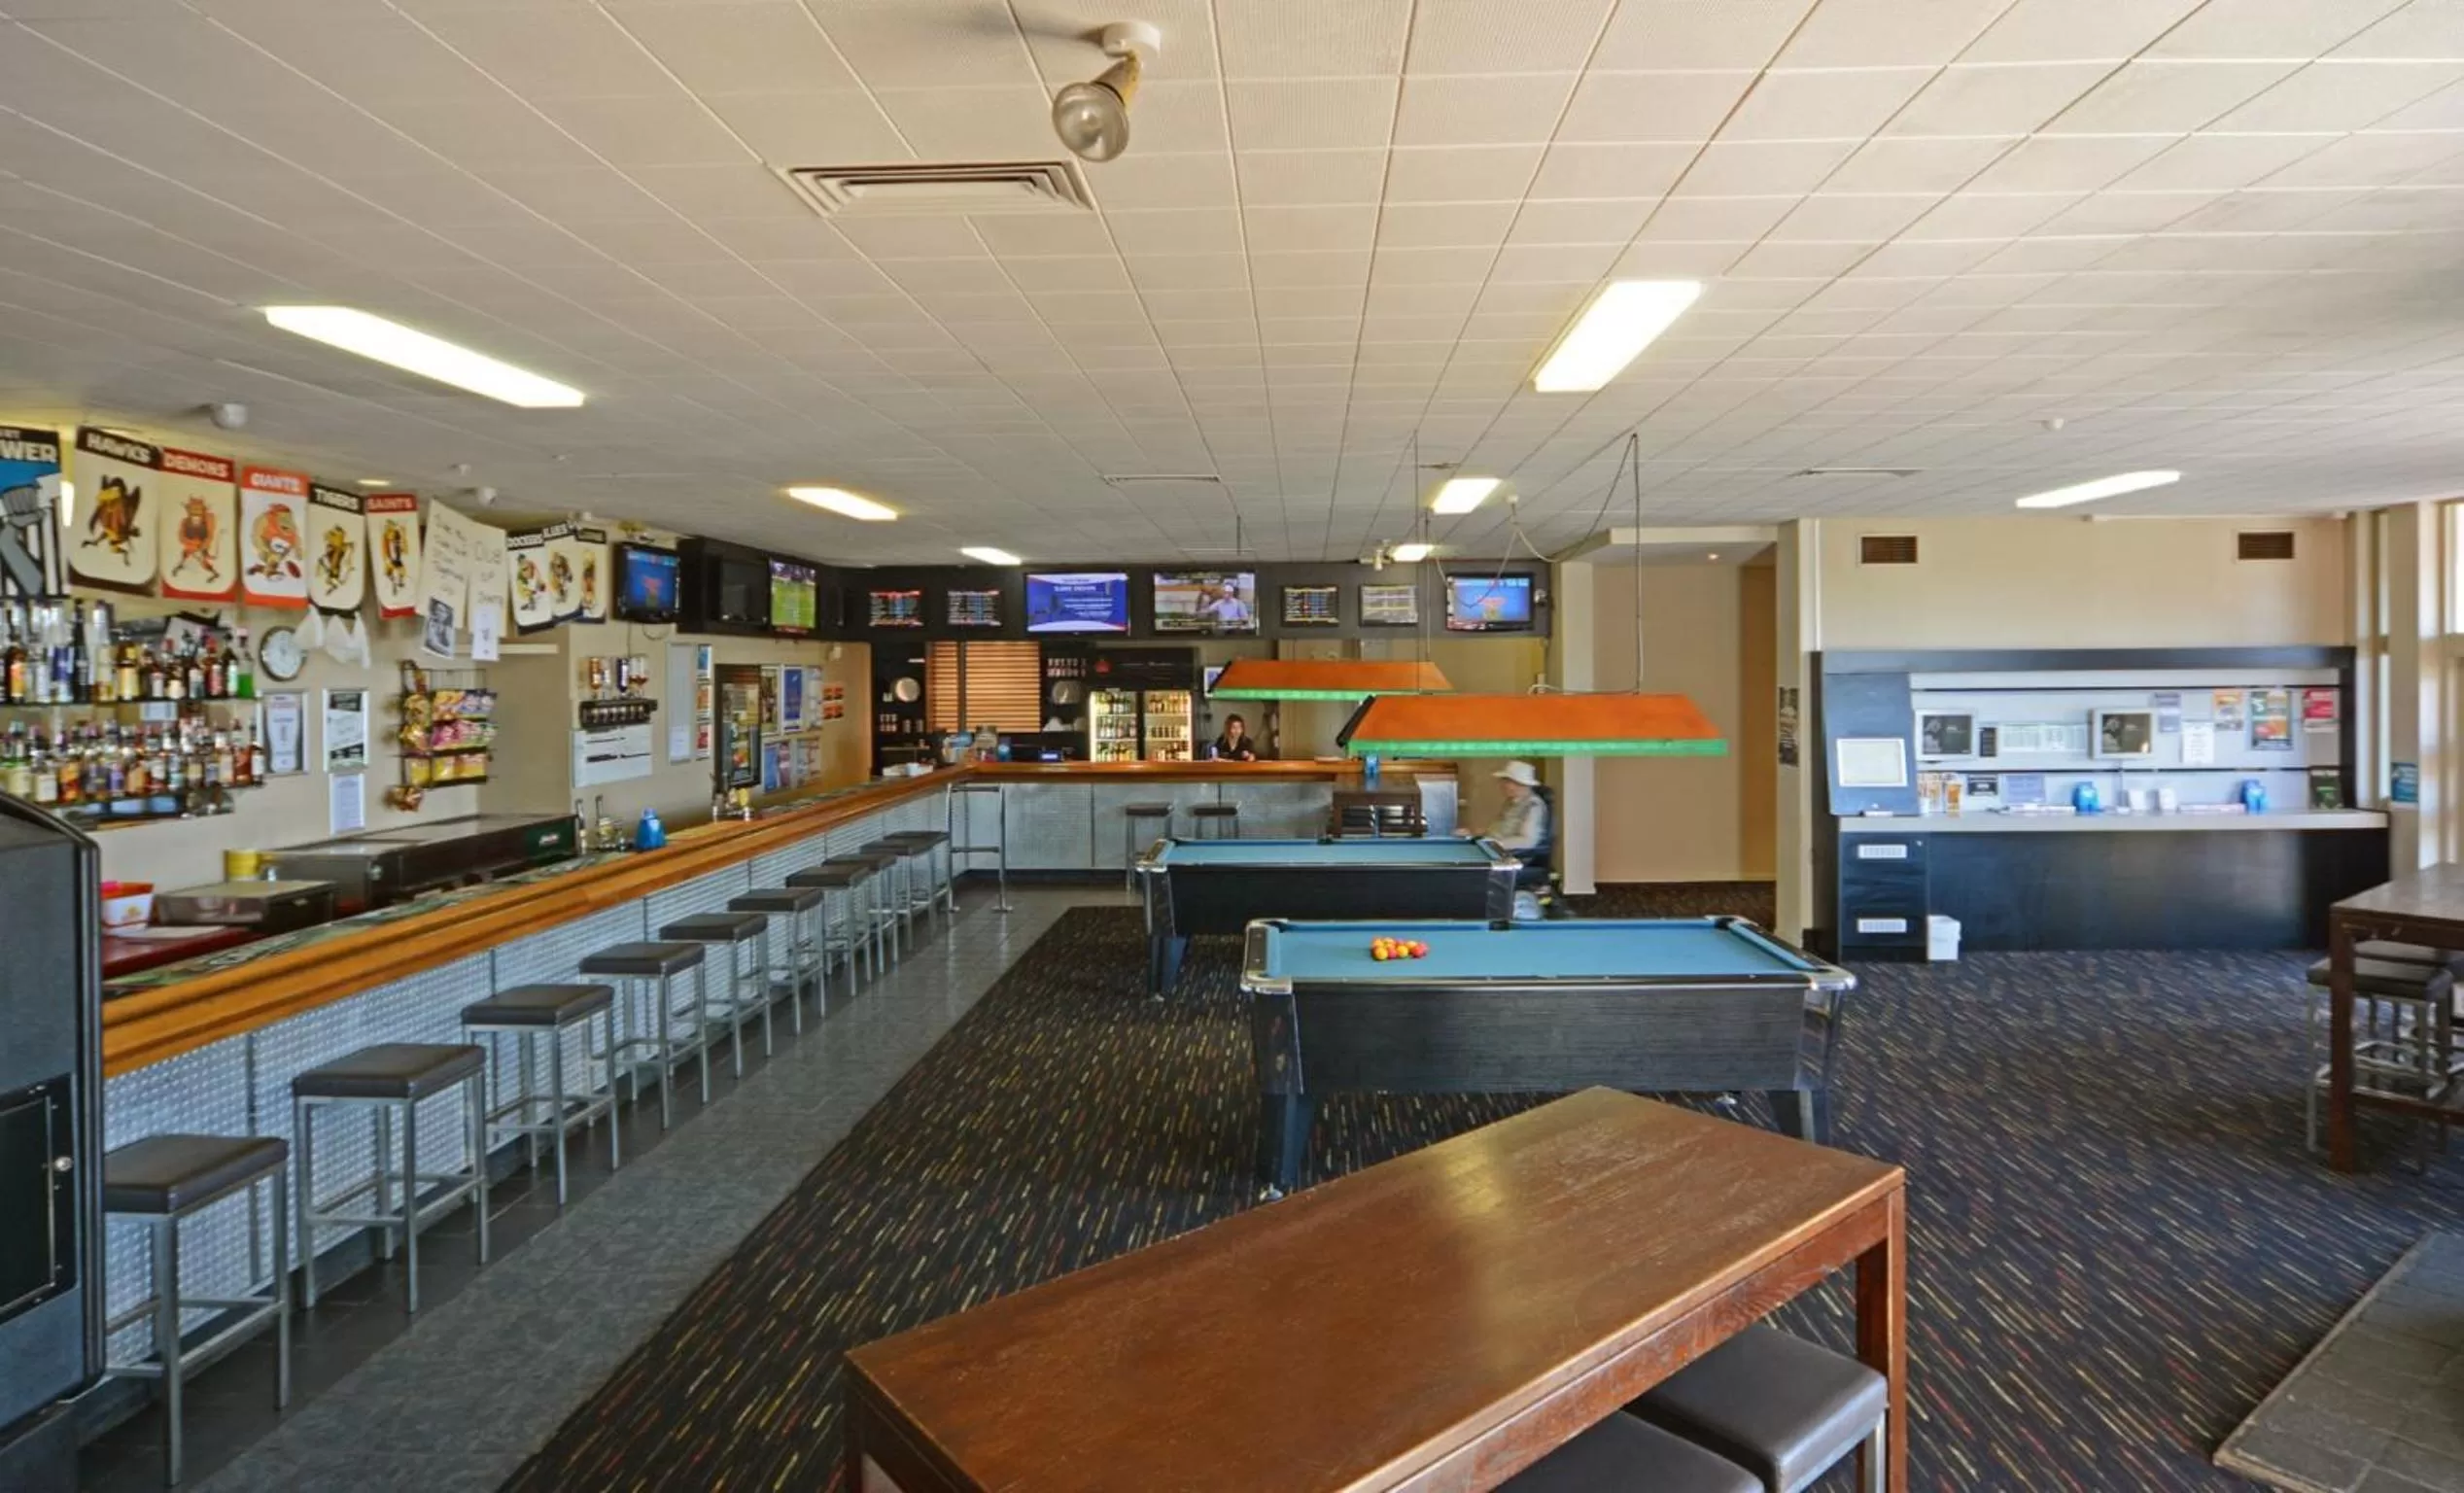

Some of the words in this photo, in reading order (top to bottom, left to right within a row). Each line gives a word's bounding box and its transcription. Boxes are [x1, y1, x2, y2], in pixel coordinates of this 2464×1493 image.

[87, 433, 152, 464] HAWKS
[163, 452, 229, 478] DEMONS
[250, 472, 301, 492] GIANTS
[314, 488, 360, 510] TIGERS
[366, 497, 413, 509] SAINTS
